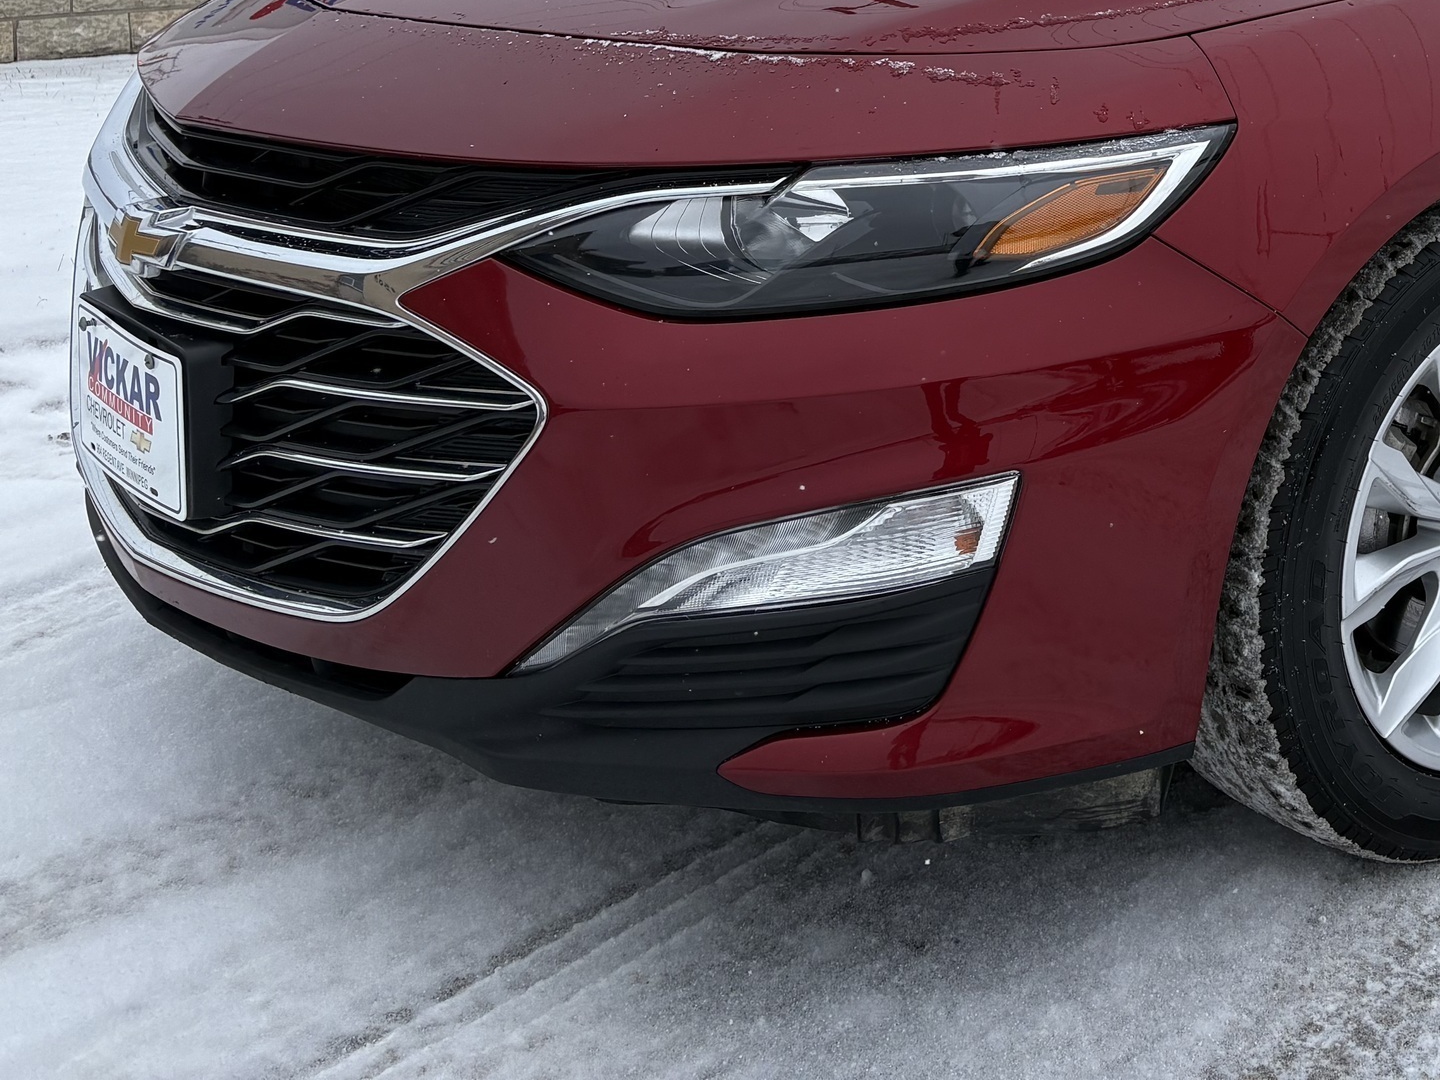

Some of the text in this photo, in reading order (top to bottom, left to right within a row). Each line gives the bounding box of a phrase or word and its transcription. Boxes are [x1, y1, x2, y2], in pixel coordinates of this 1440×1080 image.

[87, 330, 162, 422] VICKAR
[87, 375, 153, 433] COMMUNITY
[86, 394, 126, 440] CHEVROLET
